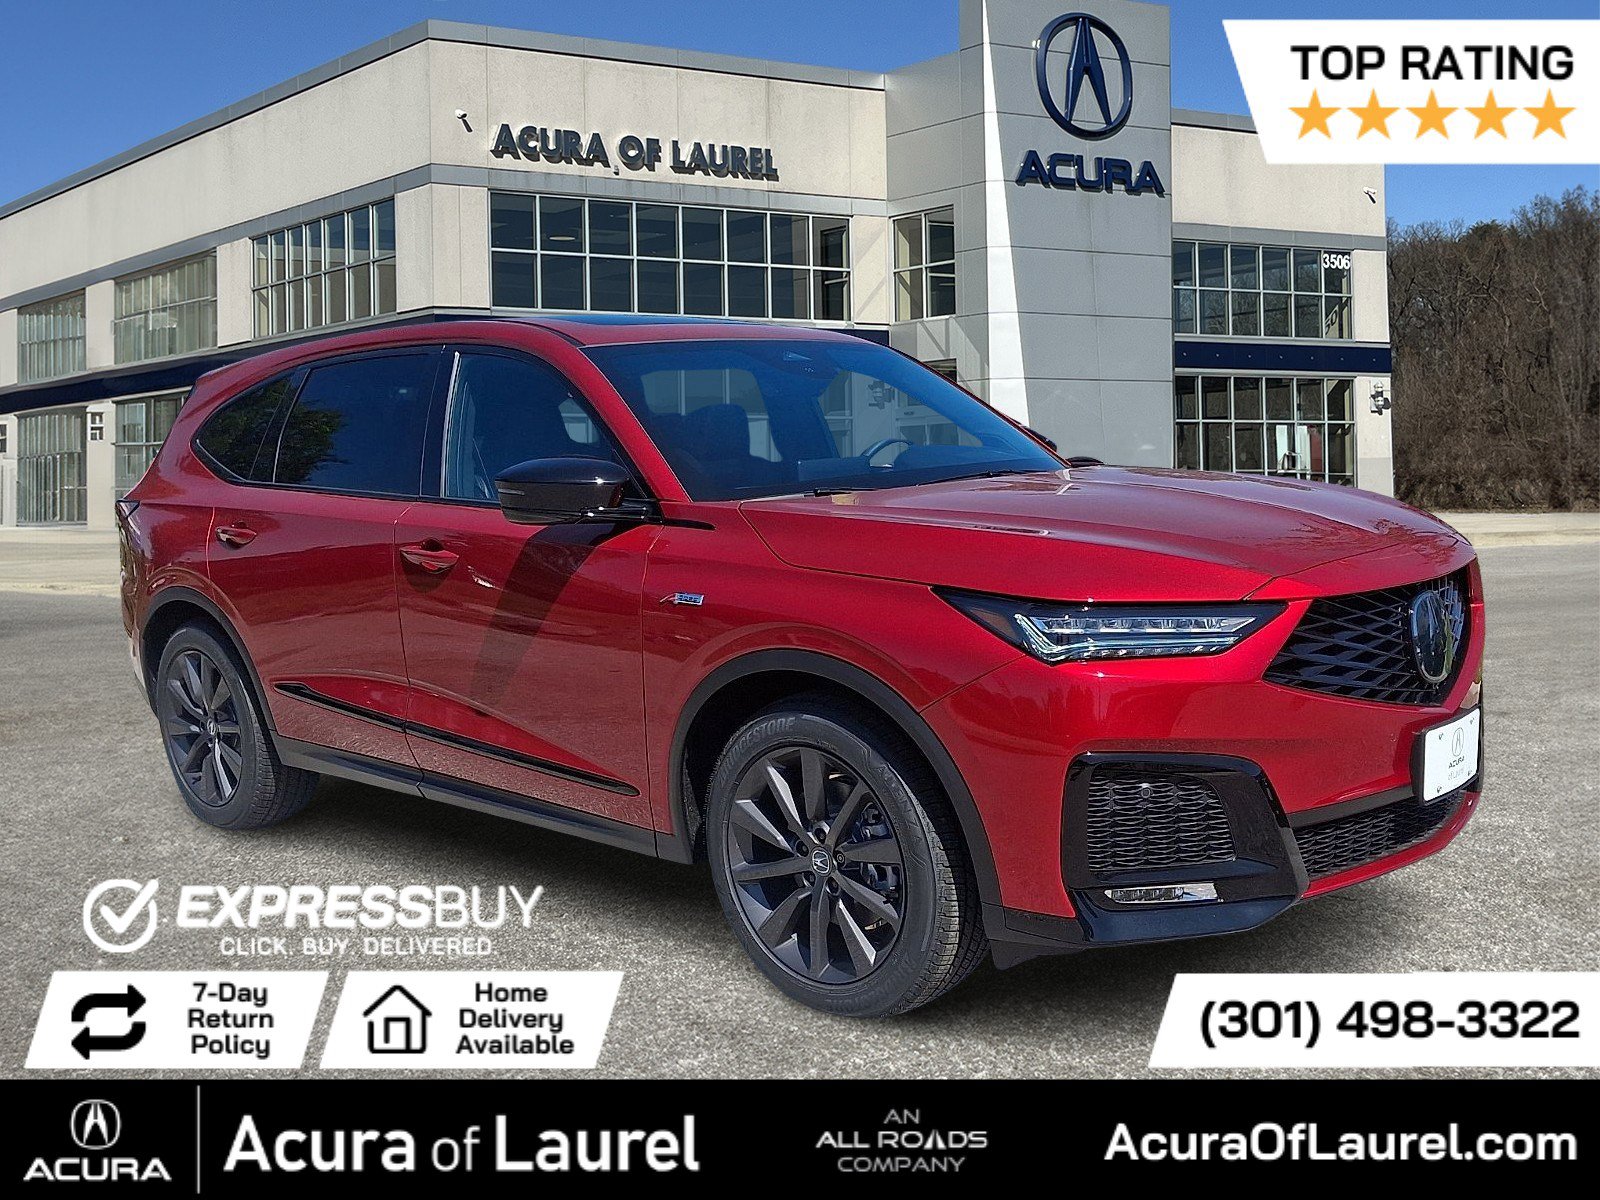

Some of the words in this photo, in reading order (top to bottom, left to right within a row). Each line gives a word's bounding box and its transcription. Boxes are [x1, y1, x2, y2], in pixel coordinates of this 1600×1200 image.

[490, 123, 611, 168] ACURA
[615, 135, 662, 172] OF
[670, 139, 779, 182] LAUREL
[1015, 149, 1166, 198] ACURA
[1322, 253, 1351, 270] 3506
